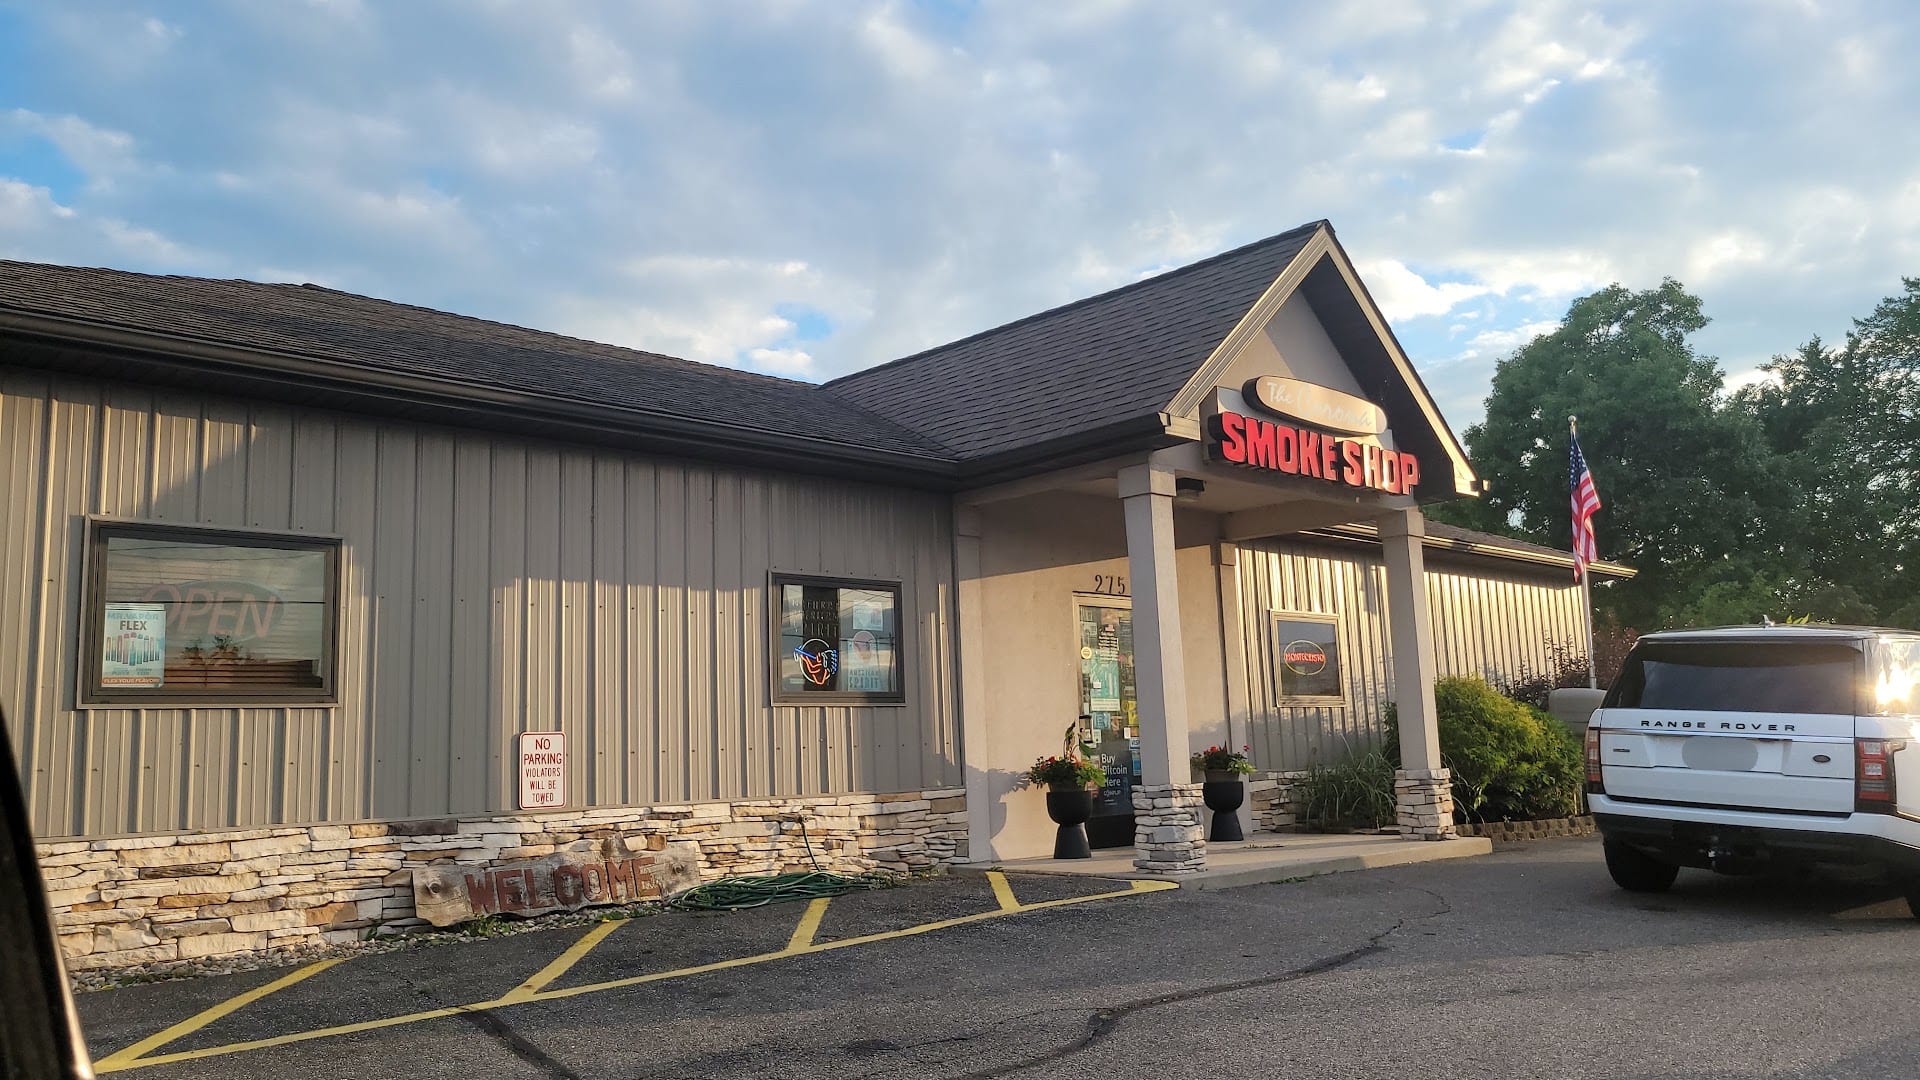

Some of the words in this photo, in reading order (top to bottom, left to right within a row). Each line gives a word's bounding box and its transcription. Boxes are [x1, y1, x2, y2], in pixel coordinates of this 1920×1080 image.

[1266, 381, 1293, 404] The
[1221, 411, 1338, 481] SMOKE
[1342, 439, 1420, 495] SHOP
[1094, 574, 1126, 595] 275
[142, 584, 277, 638] OPEN
[119, 620, 147, 631] FLEX
[1640, 720, 1706, 729] RANGE
[1720, 722, 1796, 732] ROVER
[535, 738, 551, 751] NO
[523, 752, 562, 765] PARKING
[1101, 753, 1116, 766] Buy
[525, 767, 561, 778] VIOLATORS
[1102, 764, 1128, 775] Bitcoin
[529, 780, 545, 790] WILL
[548, 780, 556, 790] BE
[532, 792, 554, 803] TOWED
[464, 856, 662, 914] WELCOME
